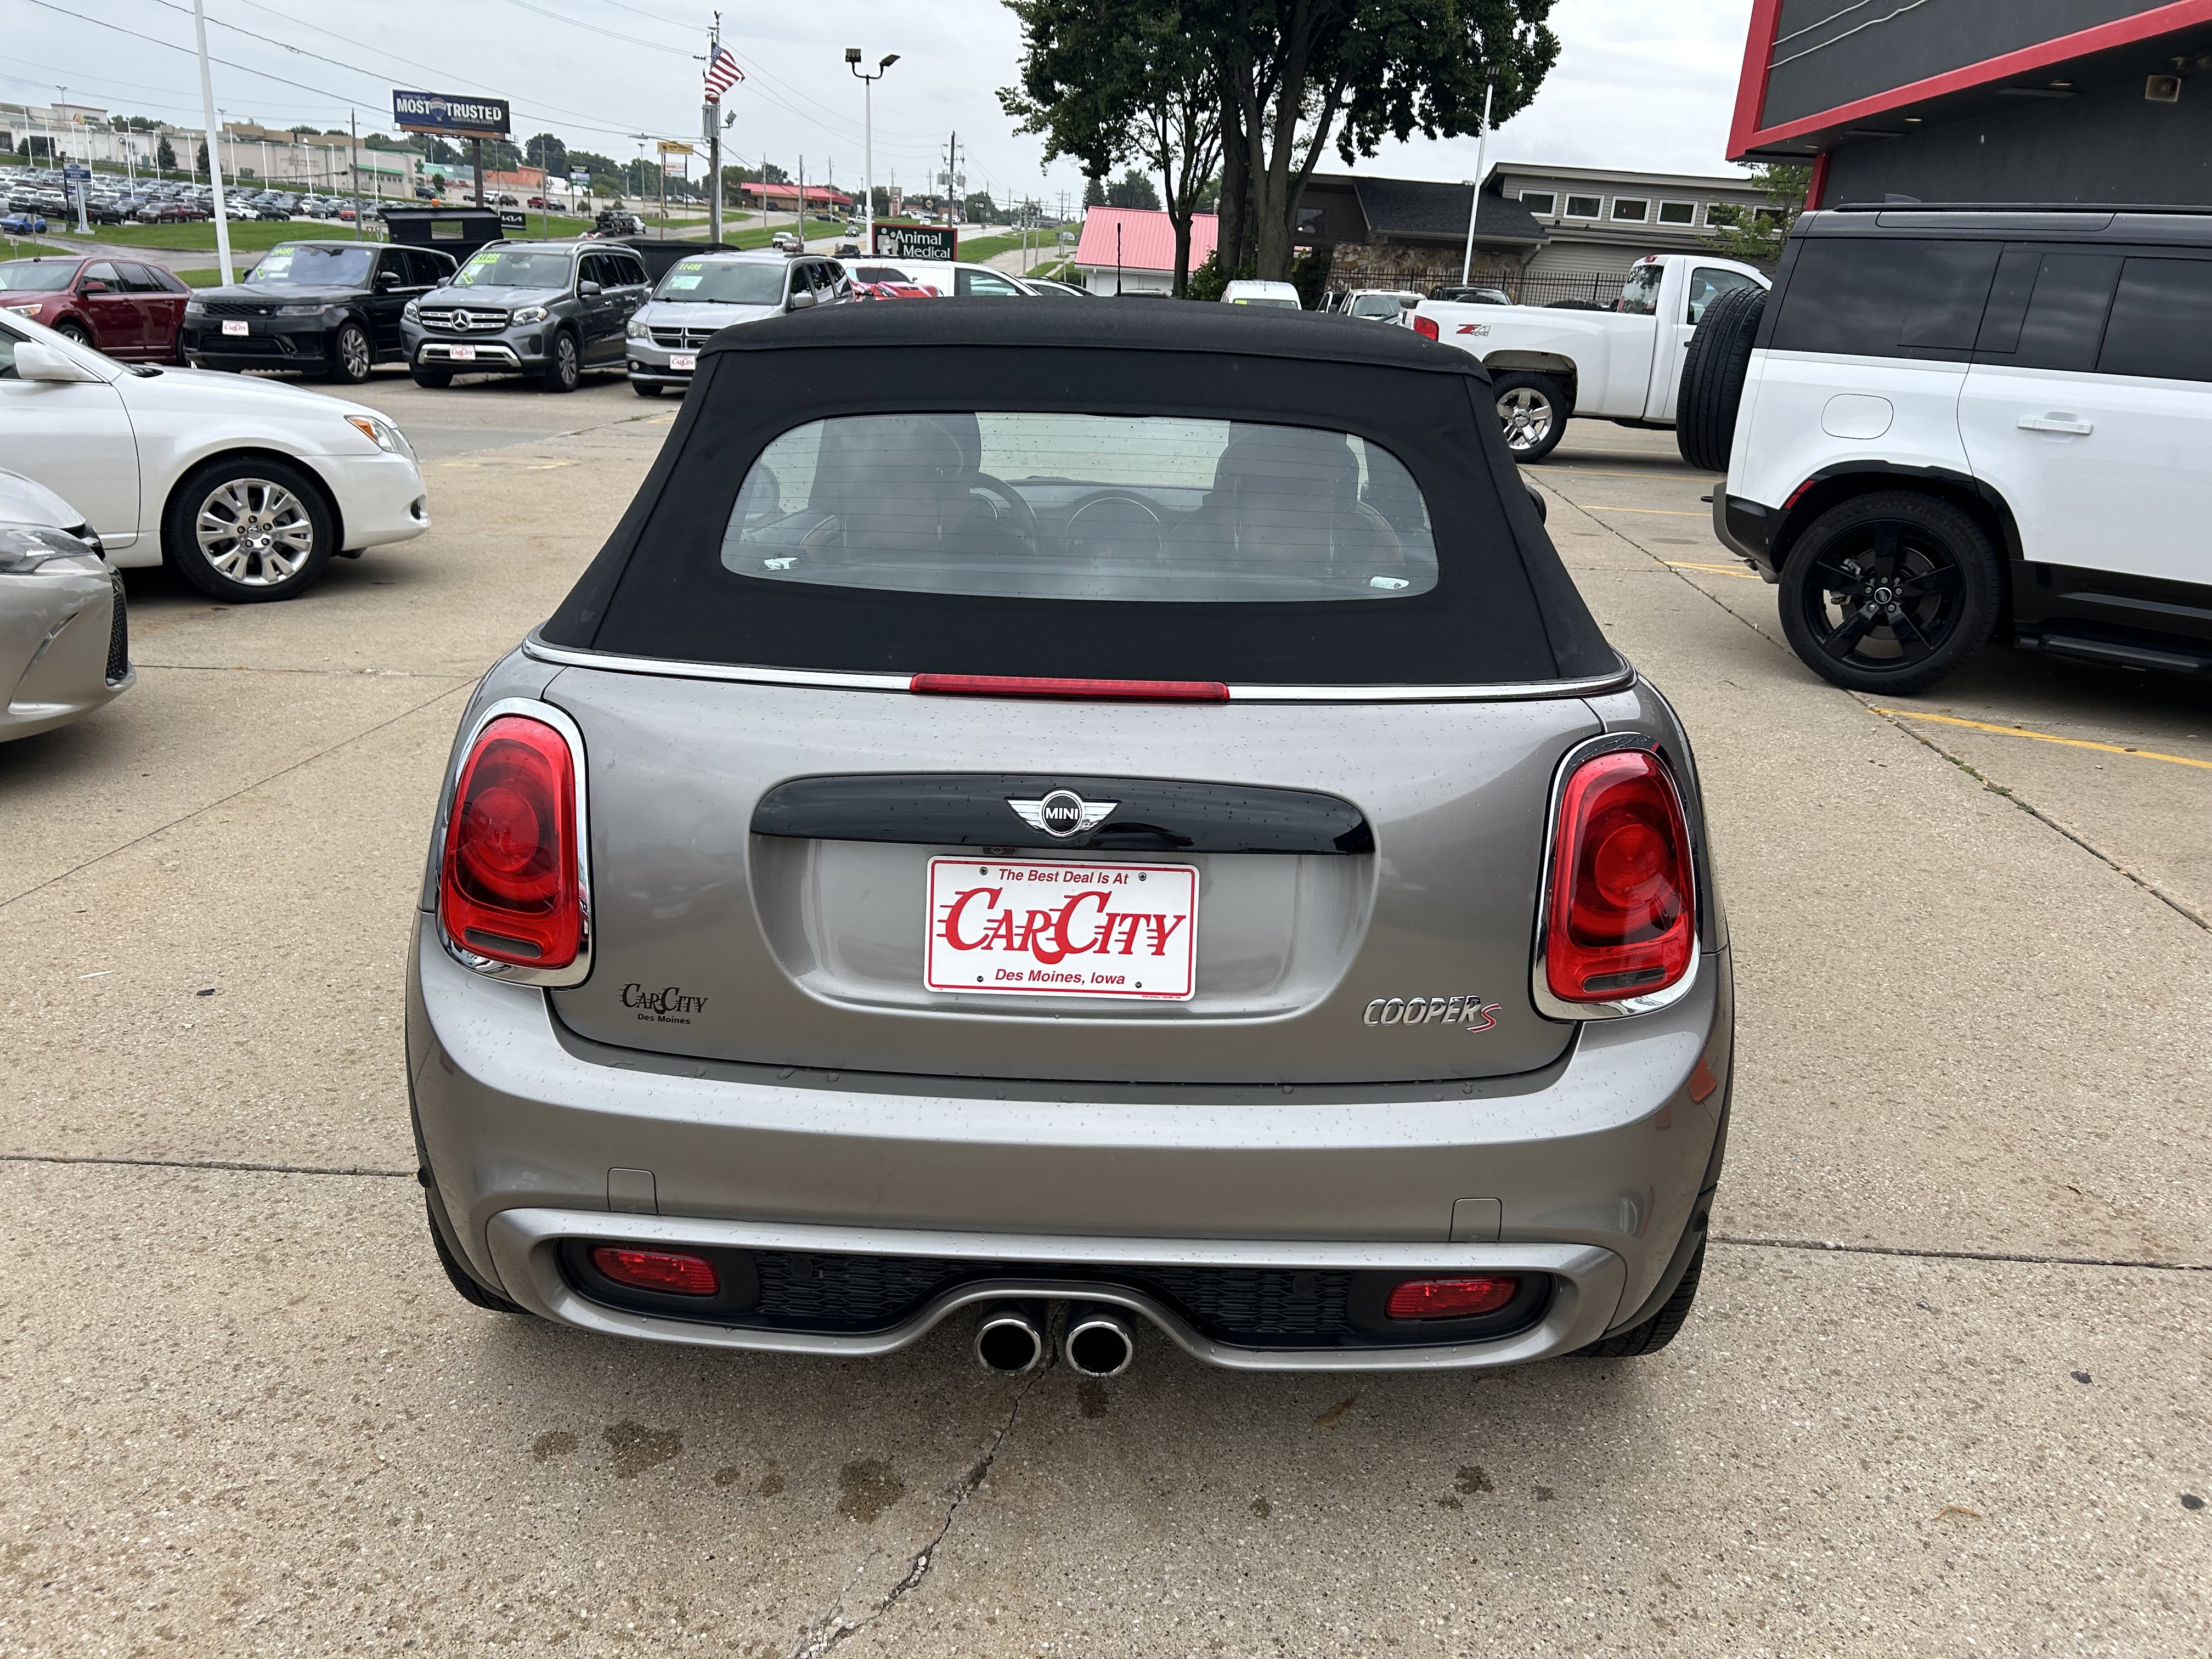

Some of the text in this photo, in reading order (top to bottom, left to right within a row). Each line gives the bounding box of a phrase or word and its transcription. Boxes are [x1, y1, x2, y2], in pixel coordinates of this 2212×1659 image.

[396, 98, 502, 121] MOST TRUSTED
[895, 229, 941, 245] Animal
[904, 245, 950, 258] Medical
[1045, 807, 1079, 820] MINI
[998, 868, 1129, 884] The Best Deal Is At
[995, 968, 1125, 985] Des Moines, Iowa
[637, 1013, 691, 1024] Des Moines
